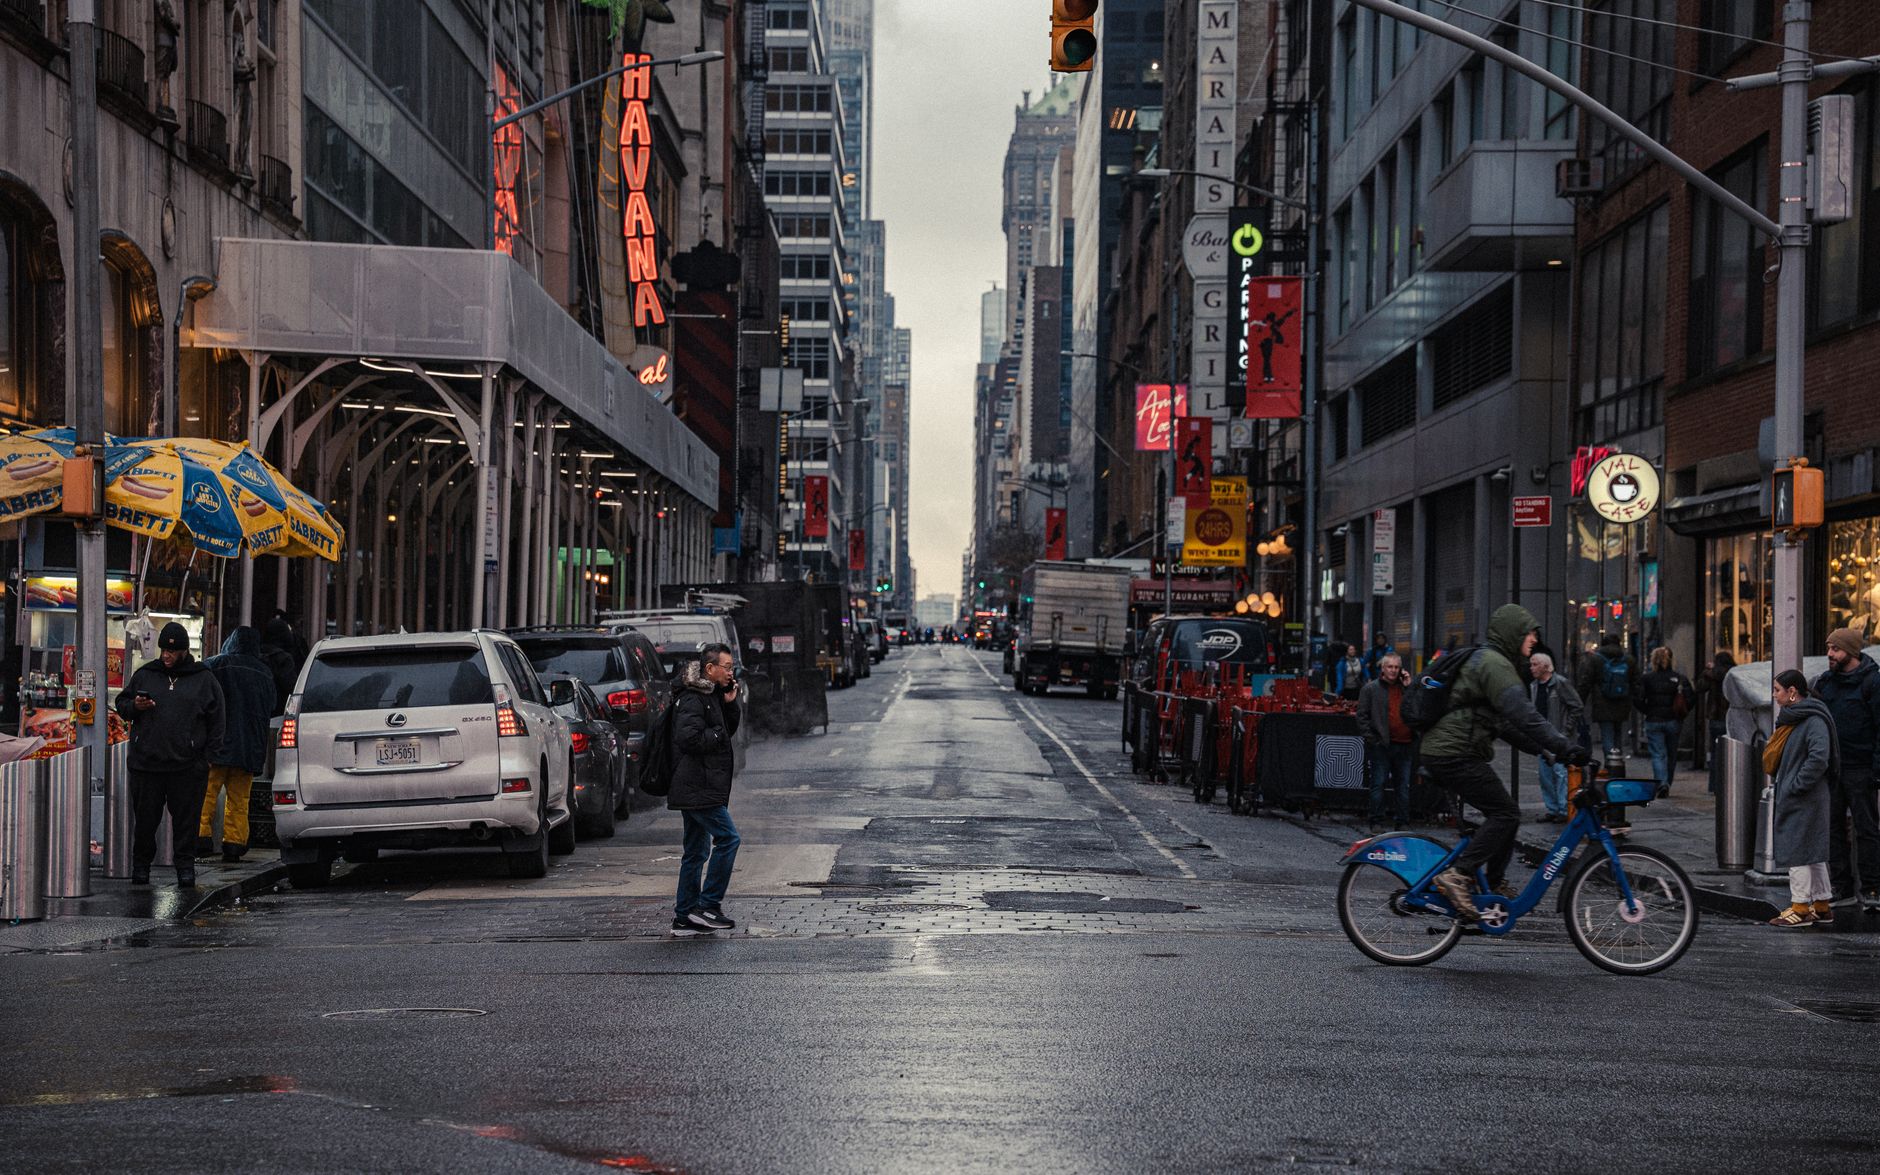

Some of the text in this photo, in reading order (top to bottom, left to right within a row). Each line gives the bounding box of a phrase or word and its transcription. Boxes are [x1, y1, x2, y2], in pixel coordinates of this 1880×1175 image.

[1206, 11, 1231, 203] MARAIS
[621, 53, 666, 327] HAVANA
[1601, 457, 1641, 478] VAL
[1598, 497, 1650, 520] CAFE
[289, 516, 335, 554] SABRETT
[1199, 521, 1231, 538] 24HRS
[1155, 591, 1209, 600] RETAURANT
[1543, 846, 1570, 881] citi bike
